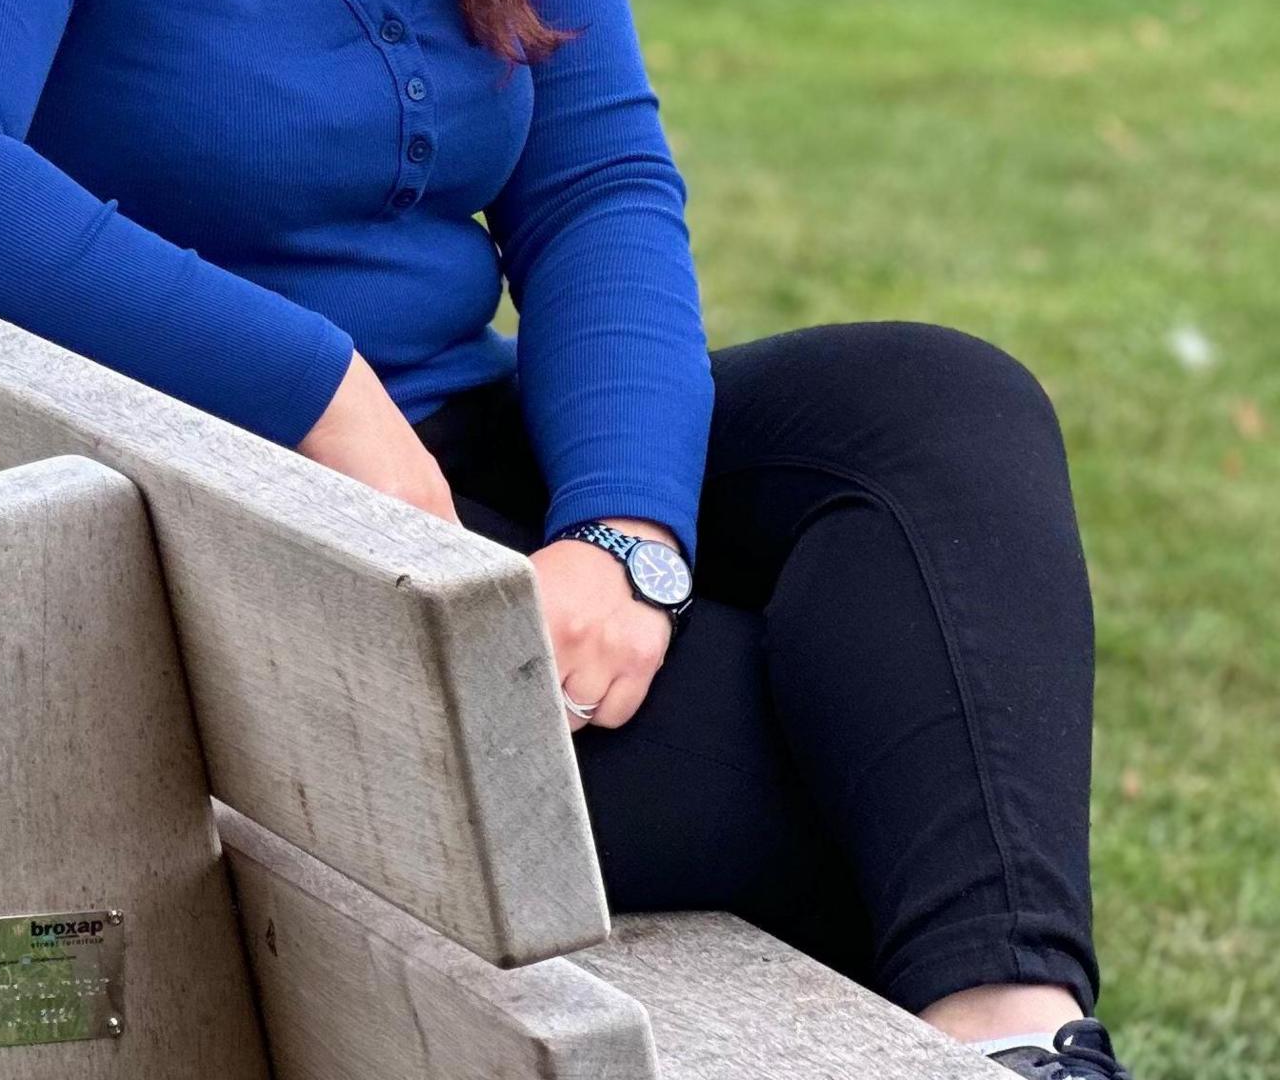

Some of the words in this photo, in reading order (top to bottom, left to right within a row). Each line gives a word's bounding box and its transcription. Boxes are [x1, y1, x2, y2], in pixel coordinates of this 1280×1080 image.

[30, 920, 103, 936] broxap
[31, 939, 58, 948] street
[62, 937, 104, 946] furniture
